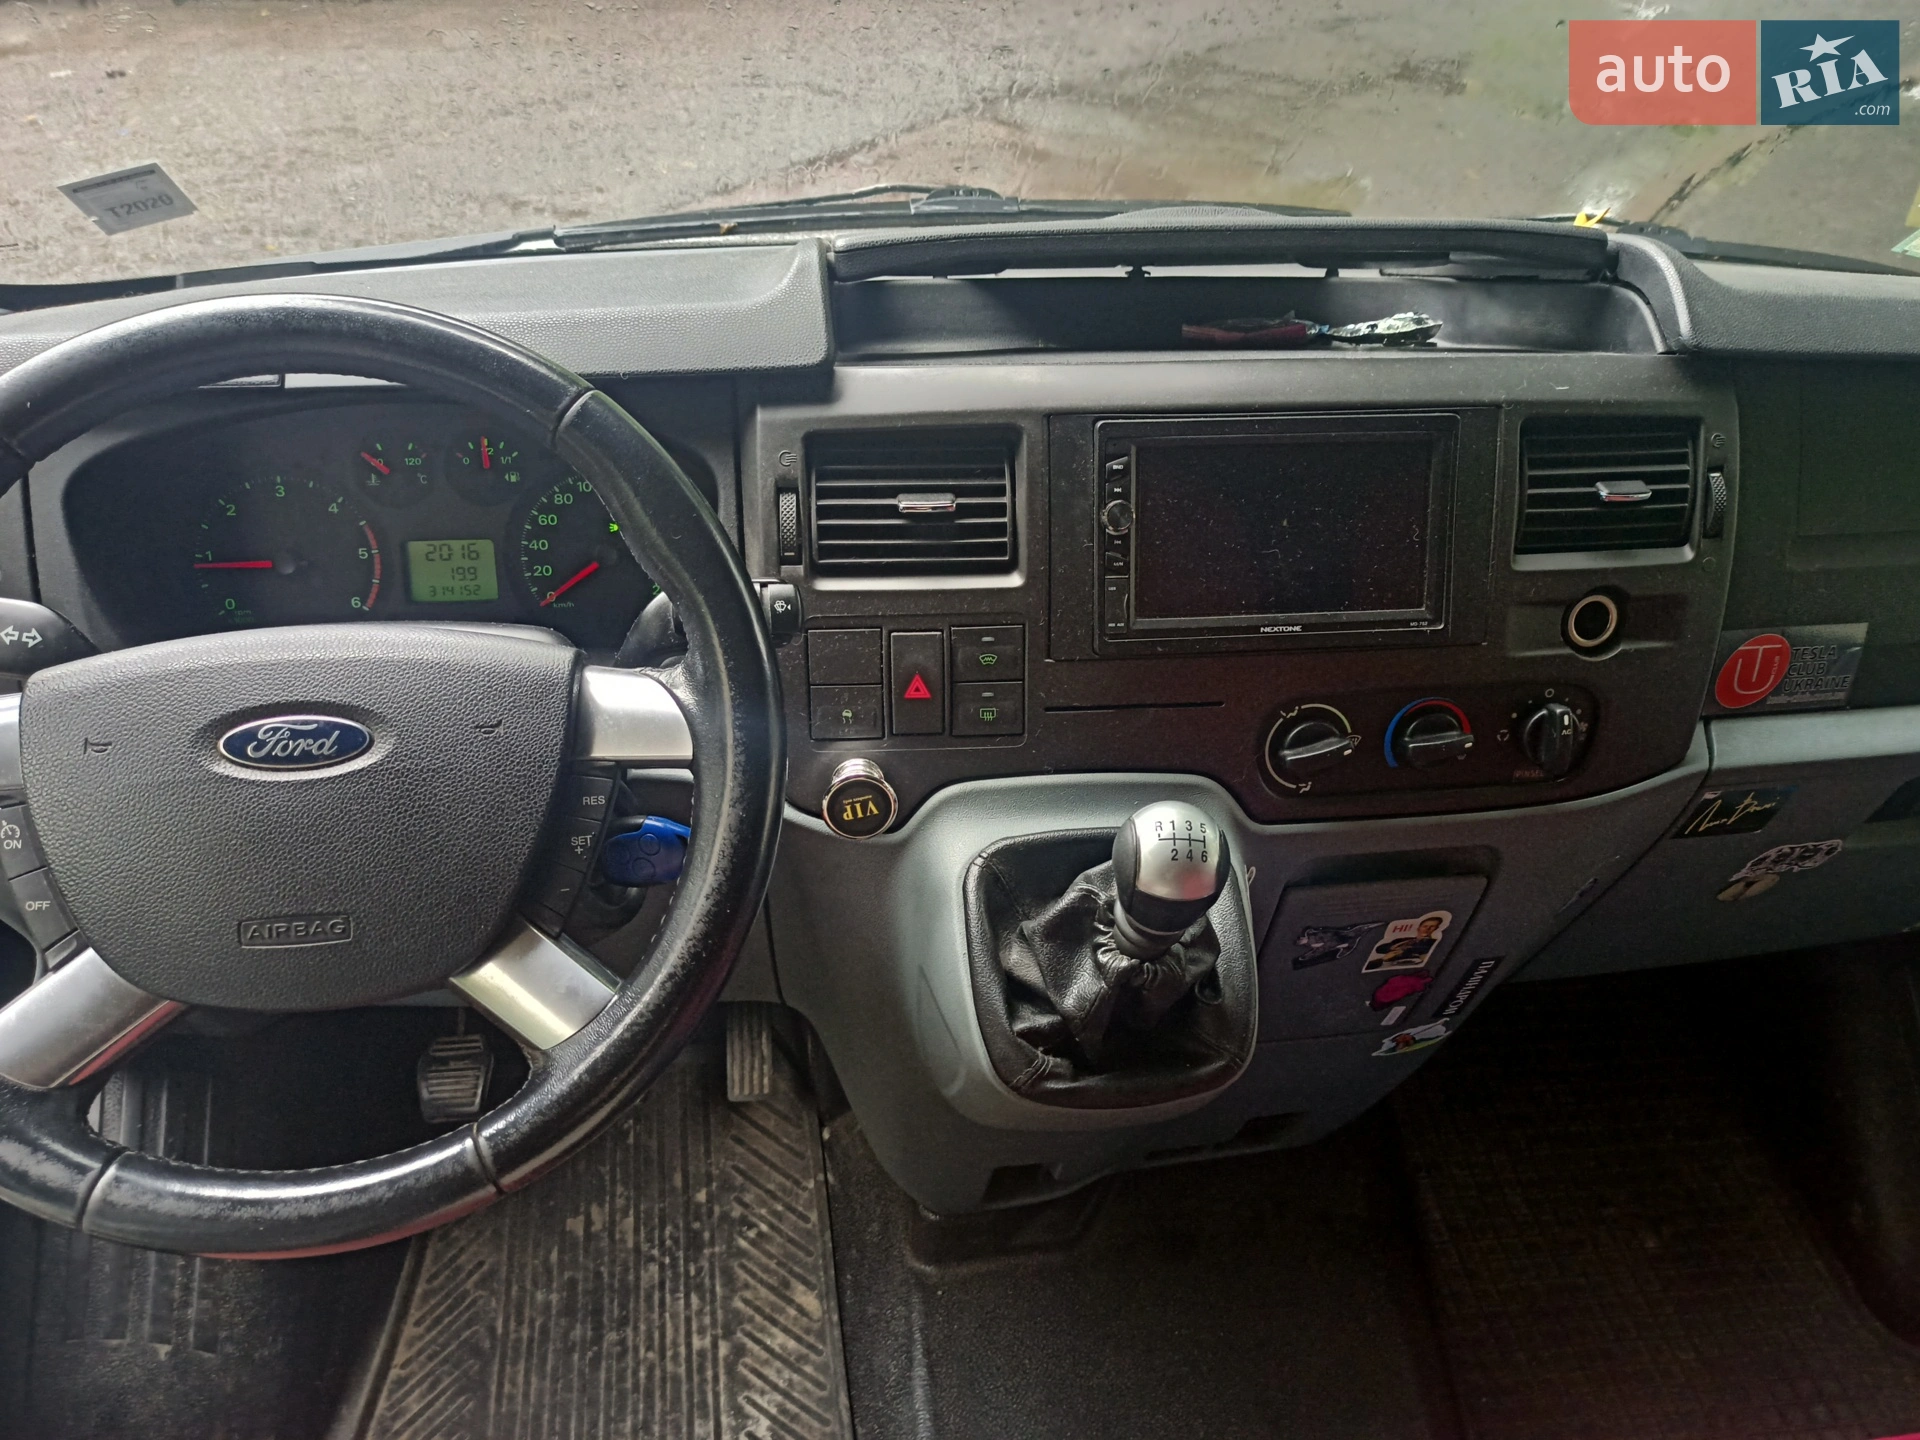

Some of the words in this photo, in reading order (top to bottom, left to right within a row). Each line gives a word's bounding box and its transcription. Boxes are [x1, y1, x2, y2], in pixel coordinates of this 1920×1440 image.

[404, 457, 422, 466] 120
[462, 457, 470, 465] 0
[275, 485, 286, 498] 3
[576, 481, 593, 493] 10
[554, 493, 573, 505] 80
[226, 504, 237, 516] 2
[328, 502, 339, 514] 4
[538, 514, 558, 526] 60
[528, 539, 549, 551] 40
[205, 550, 212, 561] 1
[358, 548, 368, 560] 5
[533, 565, 553, 576] 20
[225, 598, 236, 610] 0
[350, 596, 362, 609] 6
[1260, 625, 1303, 633] NEXTONE
[1792, 645, 1837, 661] TESLA
[1787, 661, 1827, 677] CLUB
[1782, 675, 1851, 692] UKRAINE
[247, 723, 341, 758] Ford
[582, 795, 606, 806] RES
[842, 800, 880, 821] VIP
[1154, 821, 1163, 831] R
[1169, 820, 1176, 831] 1
[1185, 820, 1193, 831] 3
[1199, 823, 1207, 833] 5
[3, 839, 22, 849] ON
[571, 835, 592, 847] SET
[1171, 848, 1179, 861] 2
[1186, 849, 1193, 862] 4
[1201, 850, 1208, 863] 6
[25, 900, 51, 911] OFF
[247, 920, 345, 941] AIRBAG
